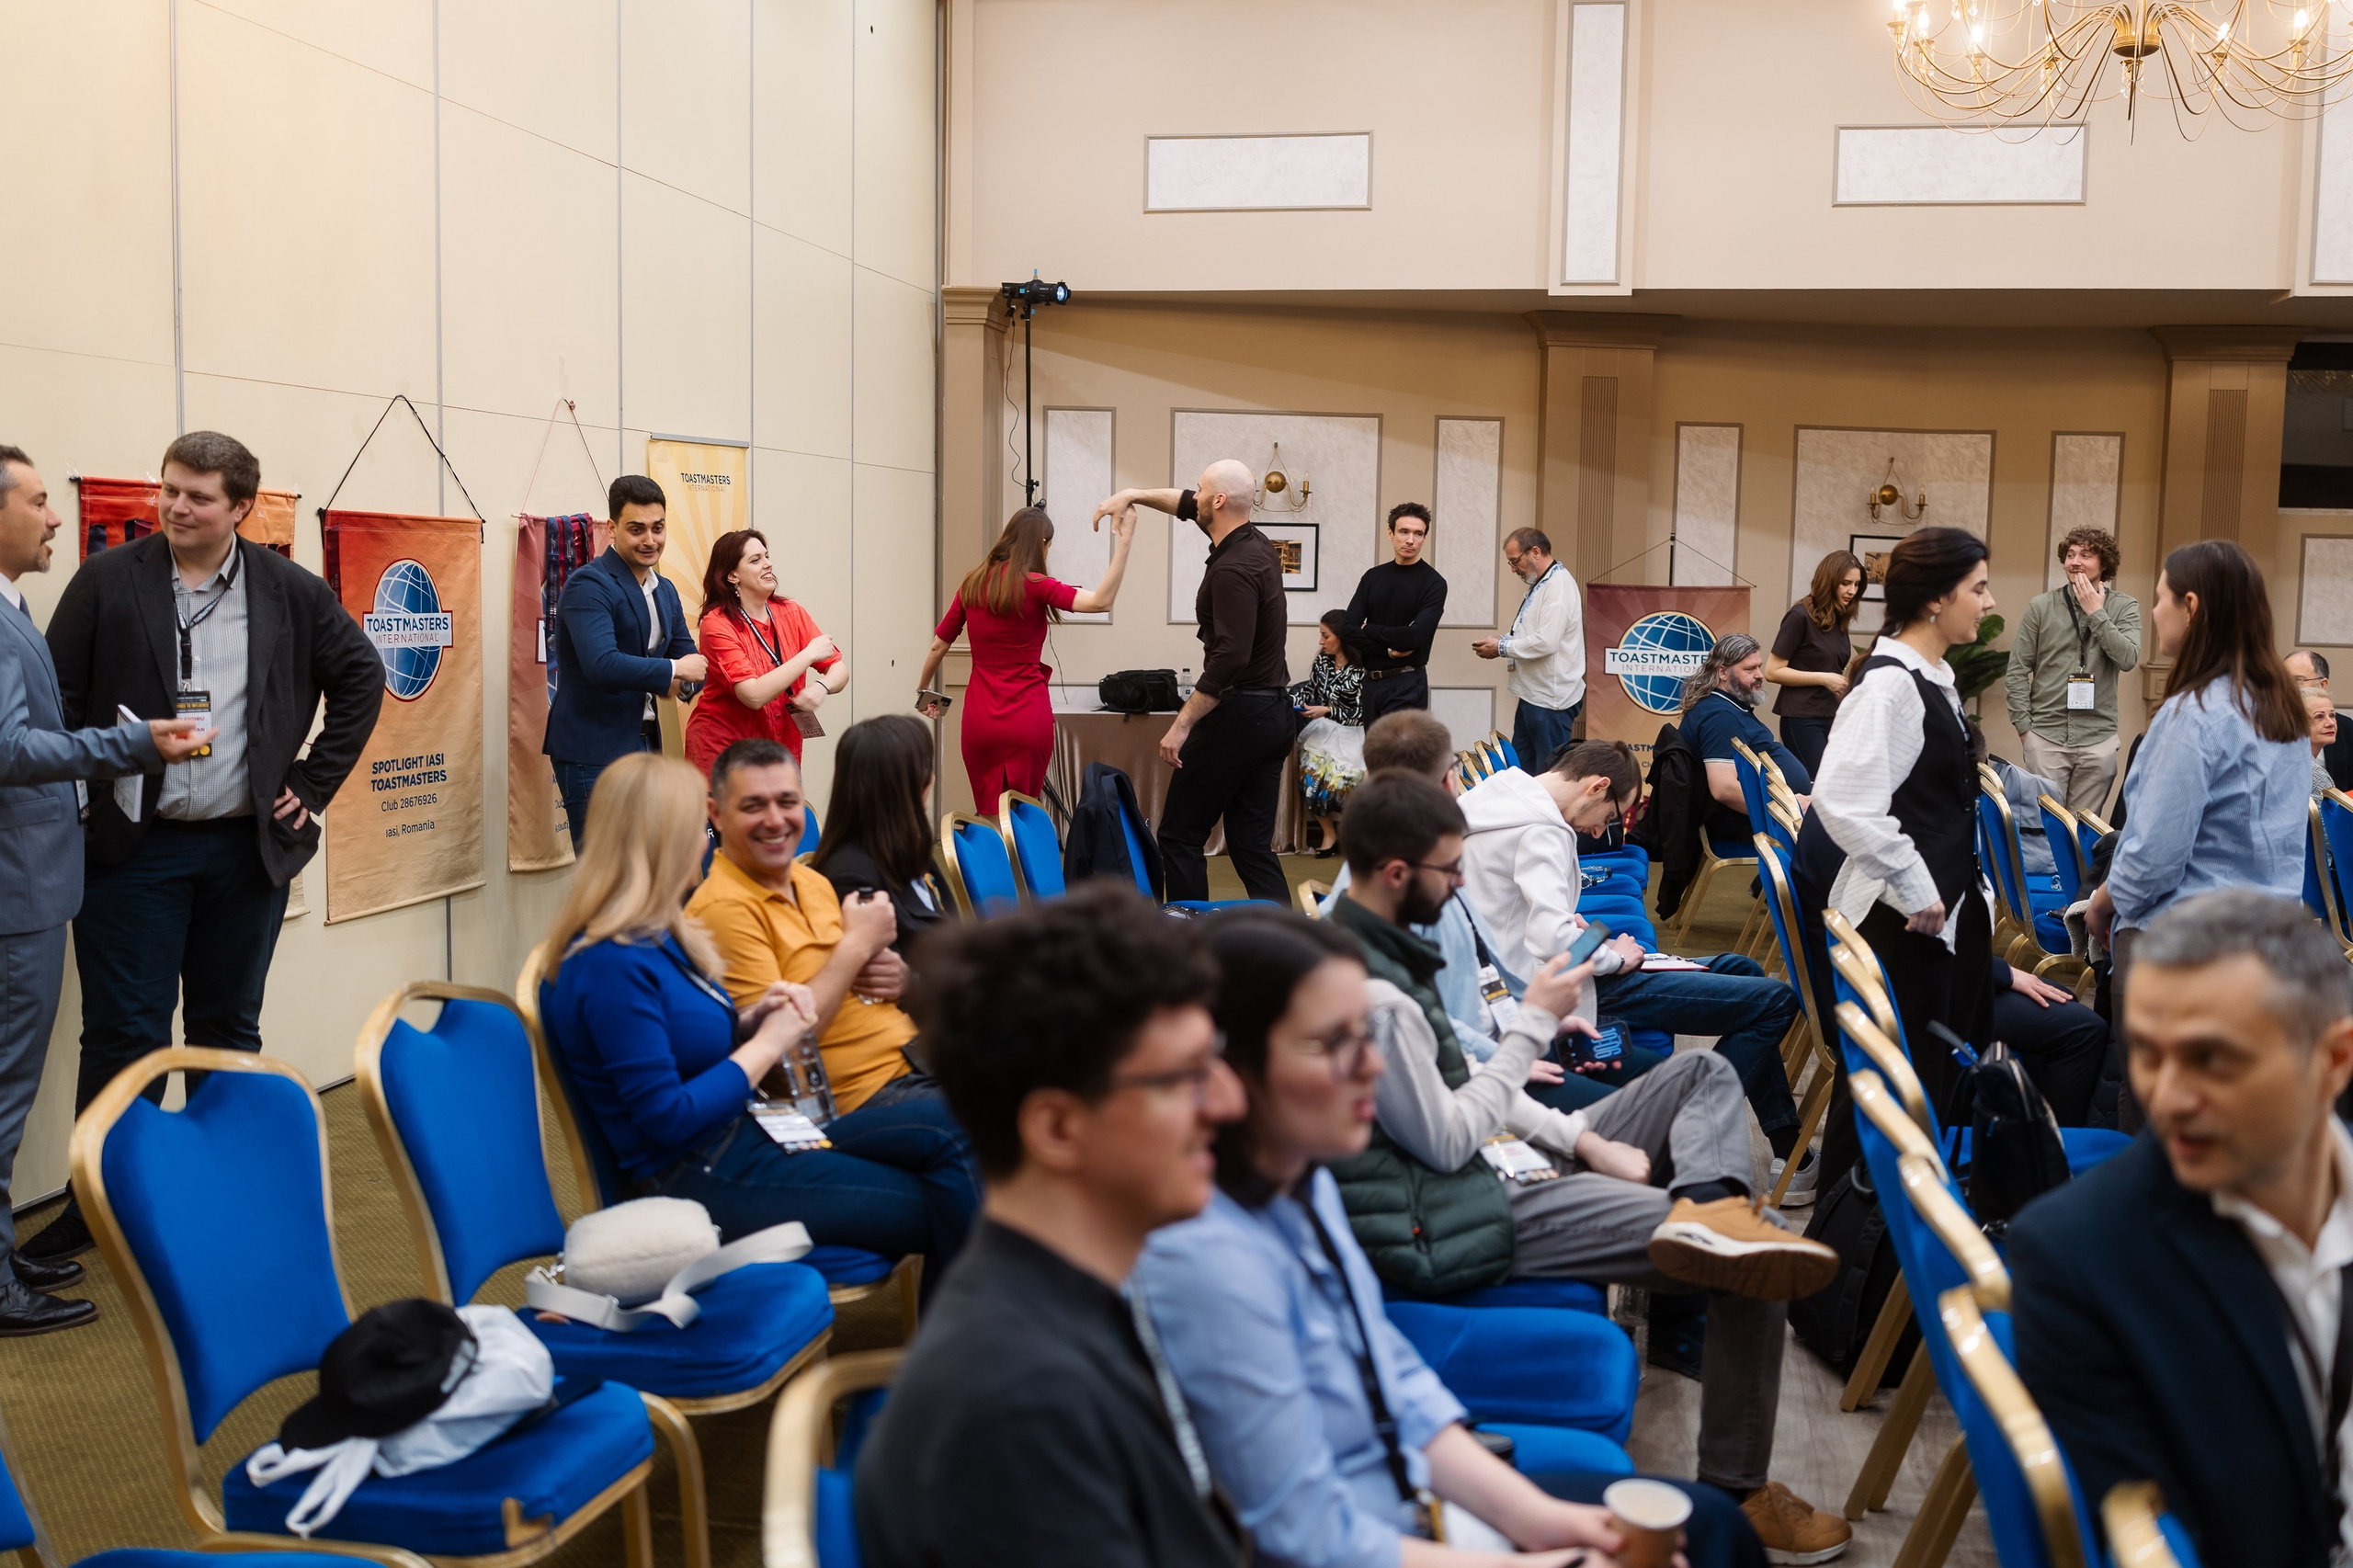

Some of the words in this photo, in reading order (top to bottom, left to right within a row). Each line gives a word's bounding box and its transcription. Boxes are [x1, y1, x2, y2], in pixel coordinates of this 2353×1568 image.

[681, 472, 731, 484] TOASTMASTERS
[367, 617, 449, 631] TOASTMASTERS
[375, 632, 438, 643] INTERNATIONAL
[1609, 652, 1709, 665] TOASTMASTE
[1621, 664, 1699, 674] INTERNATION
[371, 756, 424, 775] SPOTLIGHT
[426, 753, 445, 767] IASI
[370, 769, 447, 792] TOASTMASTERS
[381, 800, 398, 812] Club
[400, 793, 438, 809] 28676926
[386, 825, 400, 837] Iasi,
[402, 820, 435, 835] Romania
